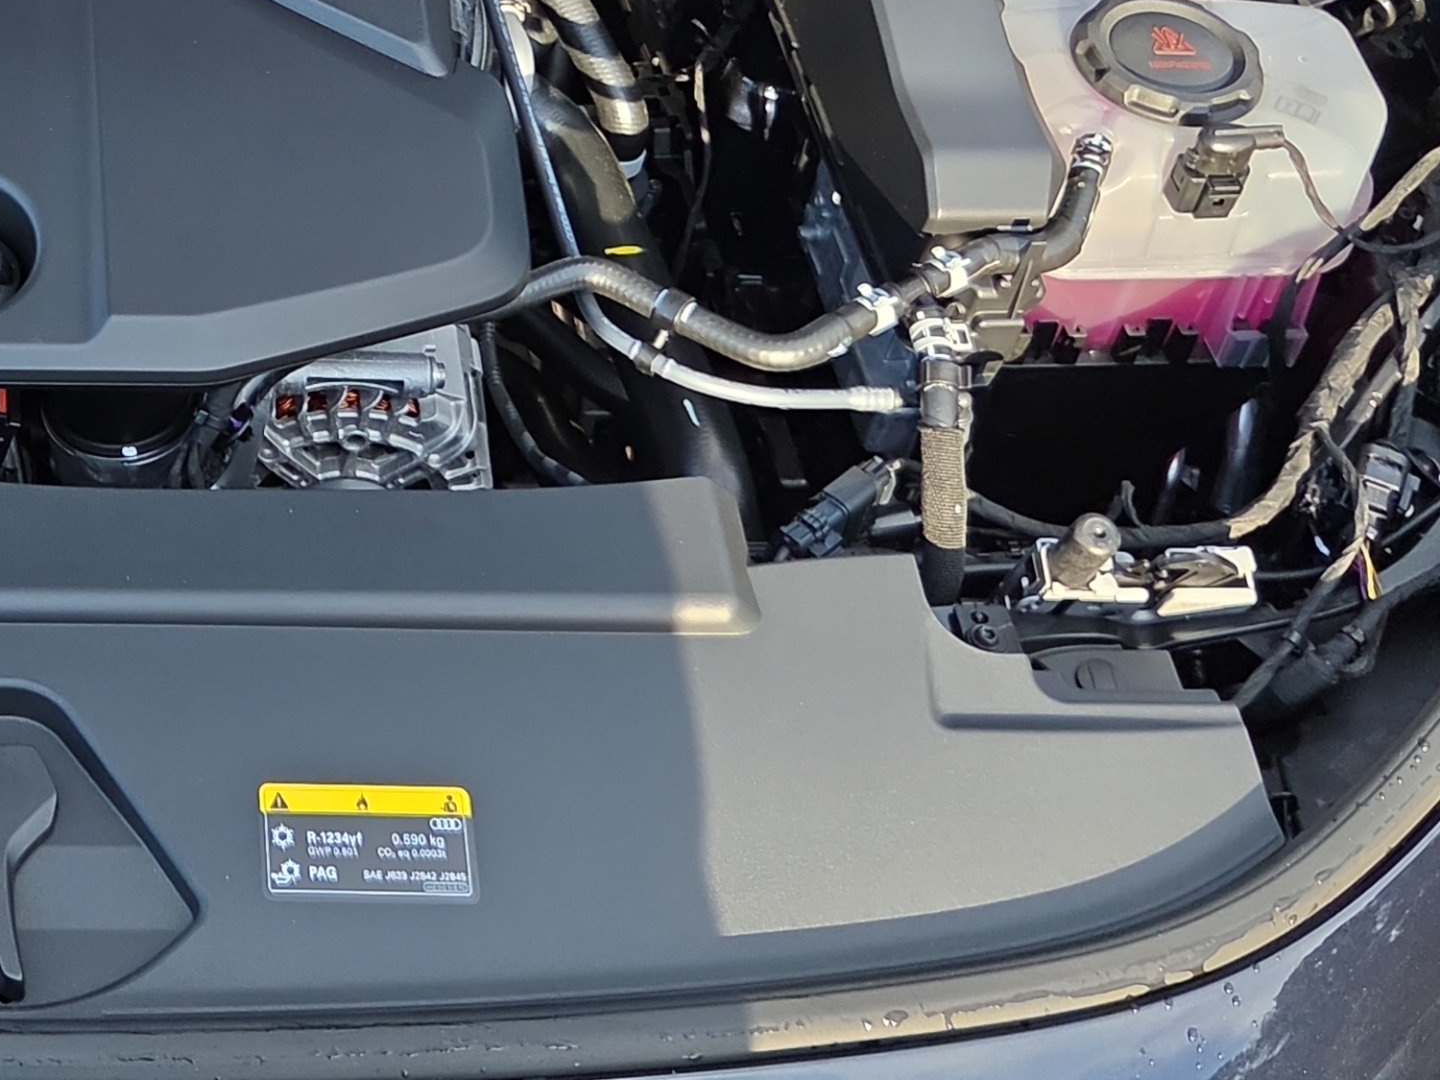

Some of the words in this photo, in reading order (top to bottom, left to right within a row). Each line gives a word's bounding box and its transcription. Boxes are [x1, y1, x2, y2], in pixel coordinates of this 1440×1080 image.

[306, 831, 363, 847] R-1234yf
[429, 834, 446, 848] kg
[308, 847, 332, 857] GWP
[309, 866, 338, 882] PAG
[363, 869, 383, 880] SAE
